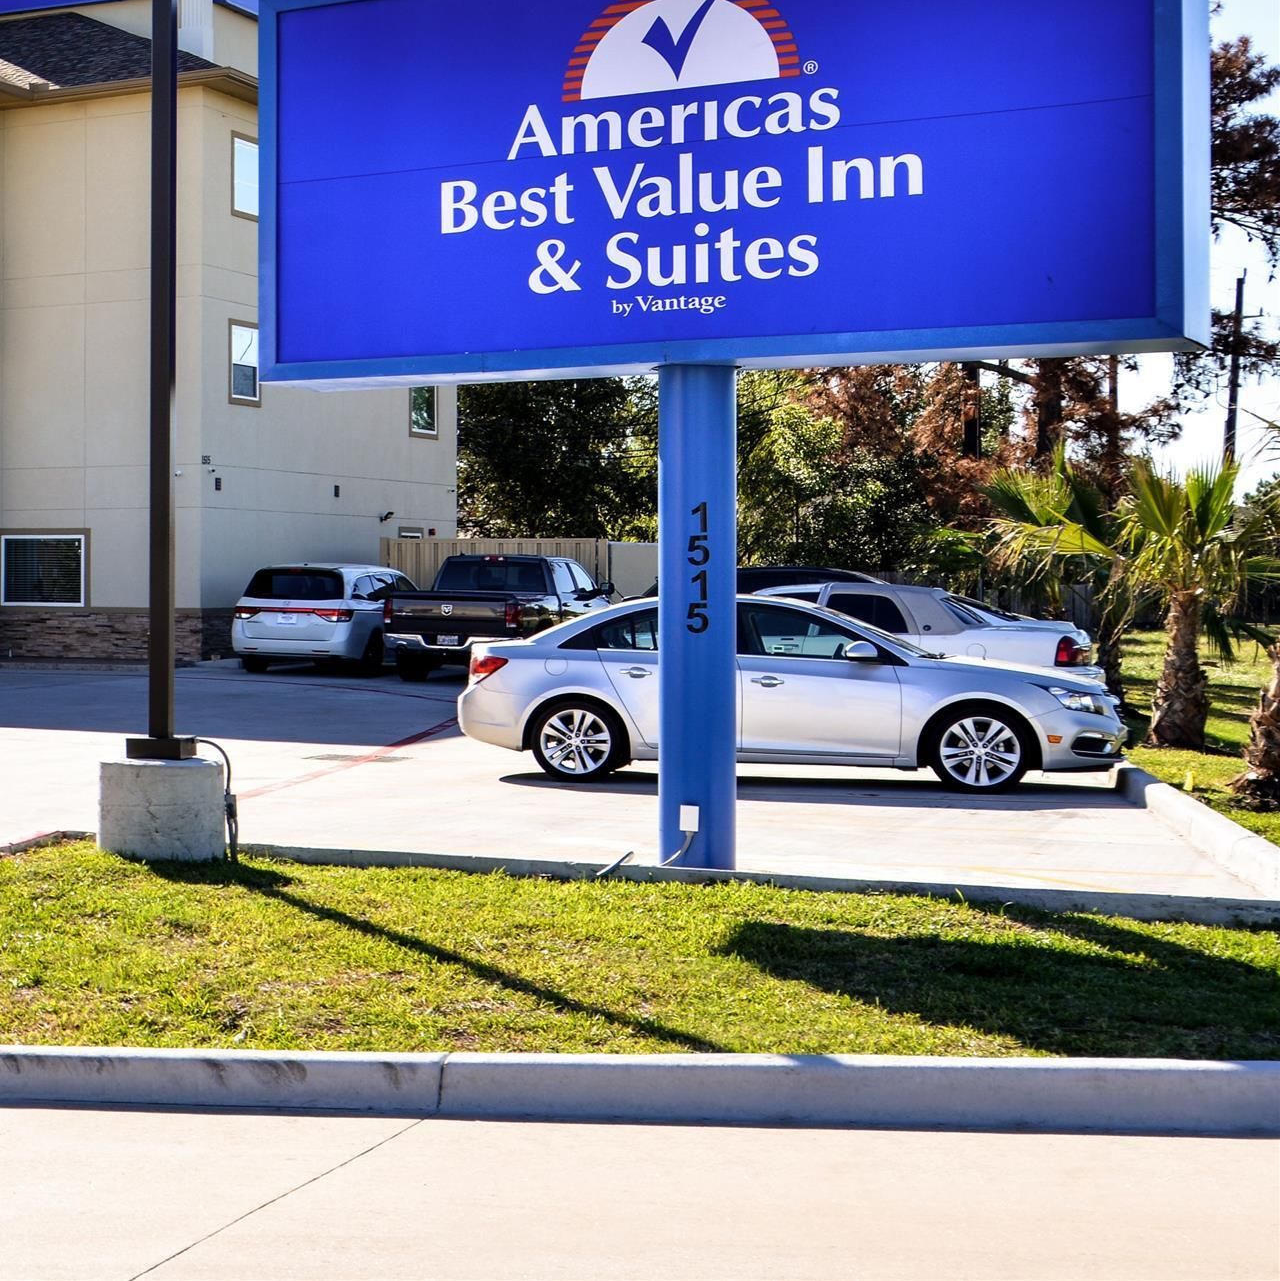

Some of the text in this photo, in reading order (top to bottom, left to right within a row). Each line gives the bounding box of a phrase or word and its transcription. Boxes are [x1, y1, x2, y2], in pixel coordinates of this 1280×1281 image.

[506, 86, 841, 161] Americas
[440, 146, 924, 234] Best Value Inn
[527, 222, 820, 296] & Suites
[611, 292, 727, 318] by Vantage
[686, 501, 710, 634] 1515
